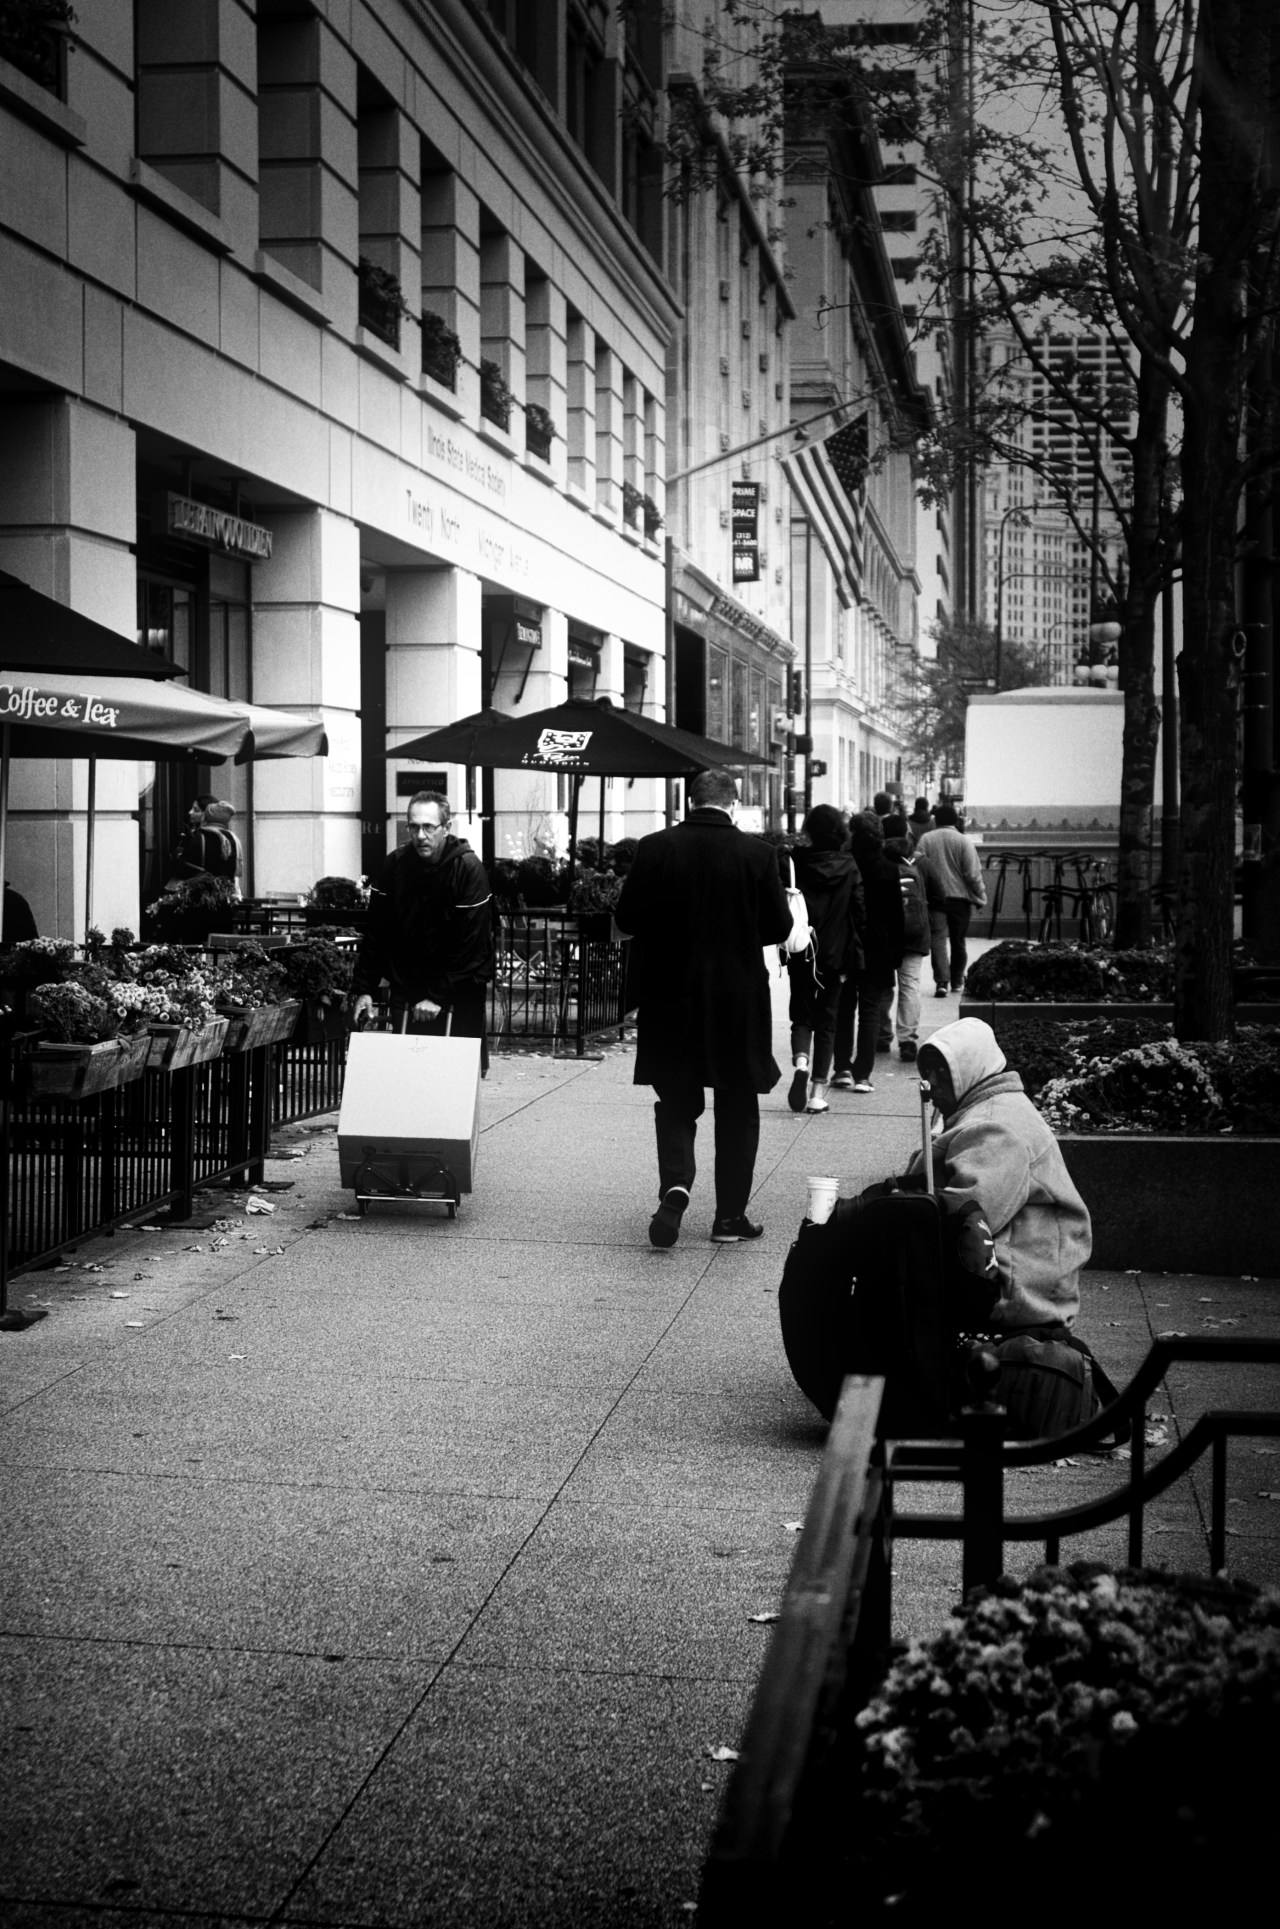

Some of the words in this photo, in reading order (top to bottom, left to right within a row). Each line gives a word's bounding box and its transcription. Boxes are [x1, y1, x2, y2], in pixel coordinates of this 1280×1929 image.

[447, 437, 464, 473] State
[465, 448, 486, 488] Medical
[732, 487, 756, 496] PRIME
[732, 508, 756, 517] SPACE
[406, 489, 434, 544] Twenty
[0, 684, 58, 719] Coffee
[60, 698, 82, 718] &
[79, 692, 117, 727] Tea
